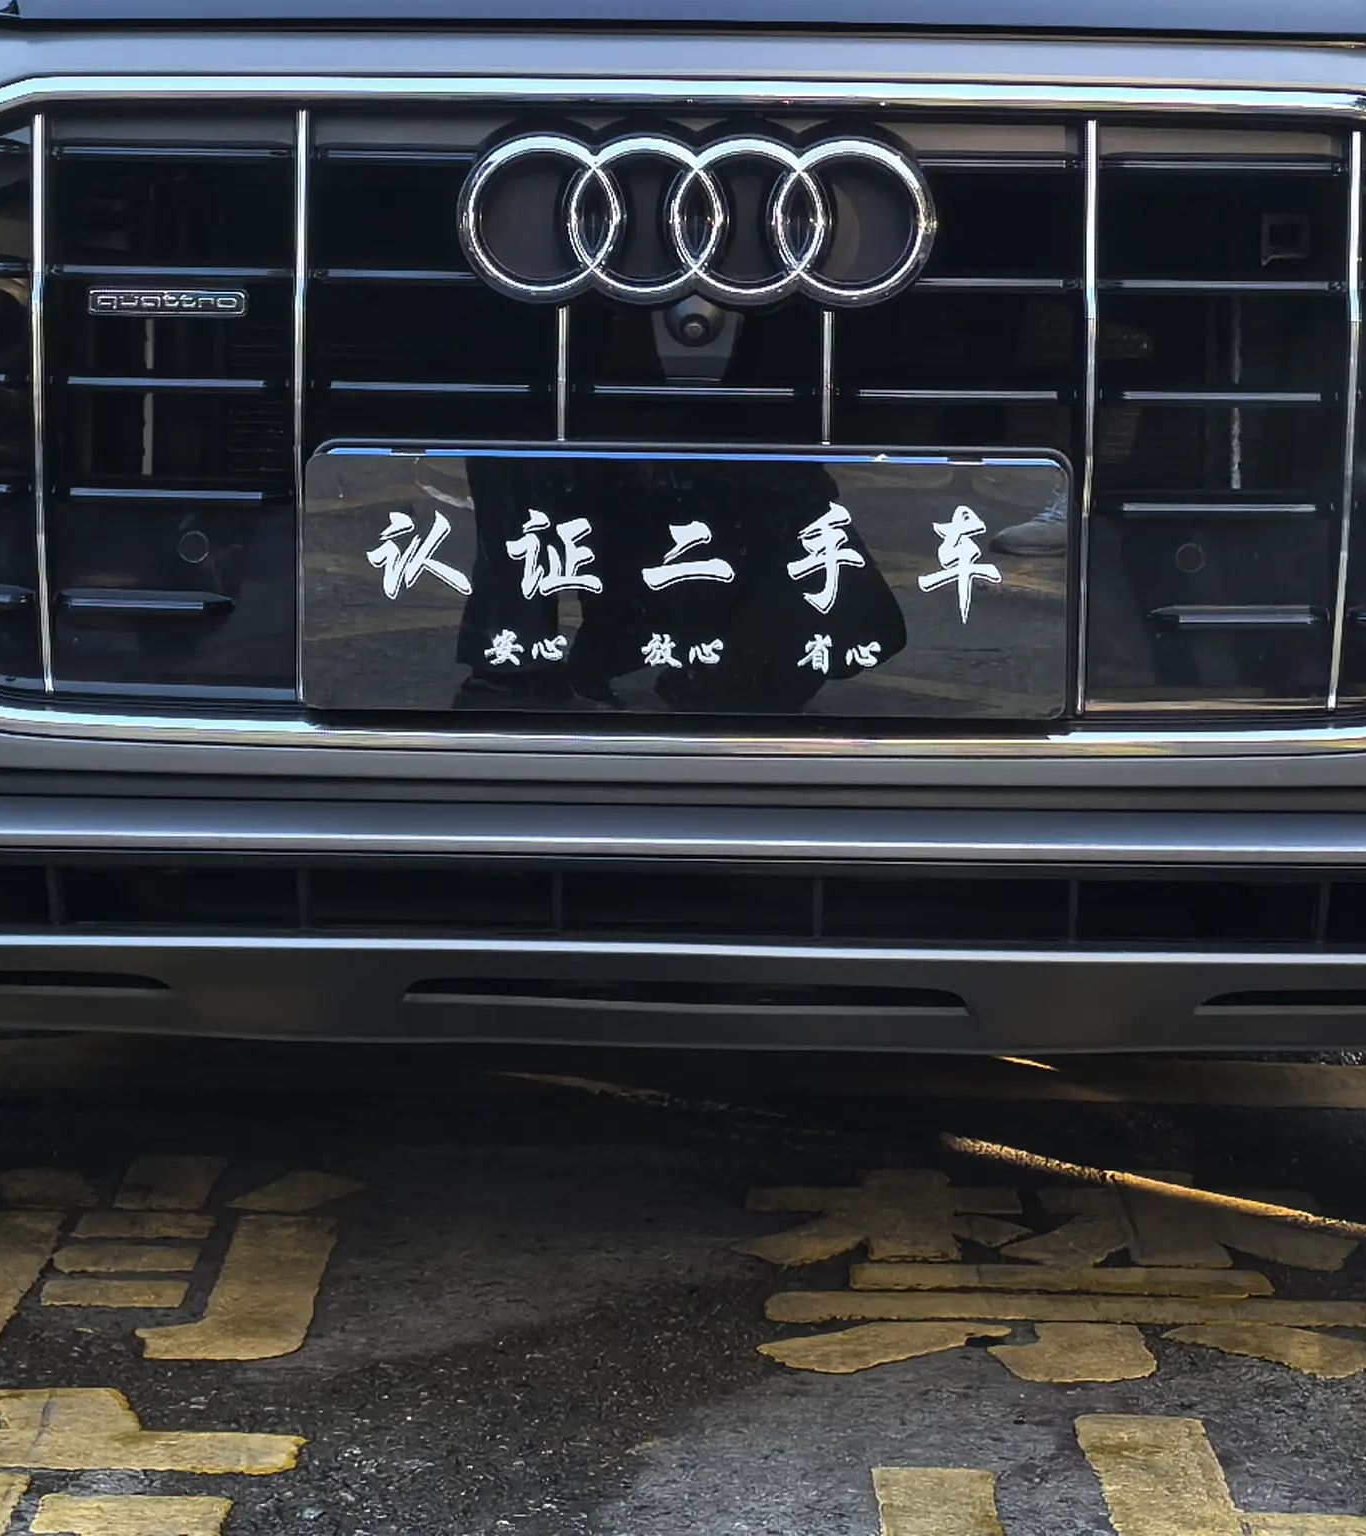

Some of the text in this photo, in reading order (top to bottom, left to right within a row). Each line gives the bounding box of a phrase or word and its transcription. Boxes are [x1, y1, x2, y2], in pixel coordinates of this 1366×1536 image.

[96, 294, 238, 310] quattro
[366, 501, 1003, 625] 认证二手车
[484, 627, 882, 675] 安心 放心 省心
